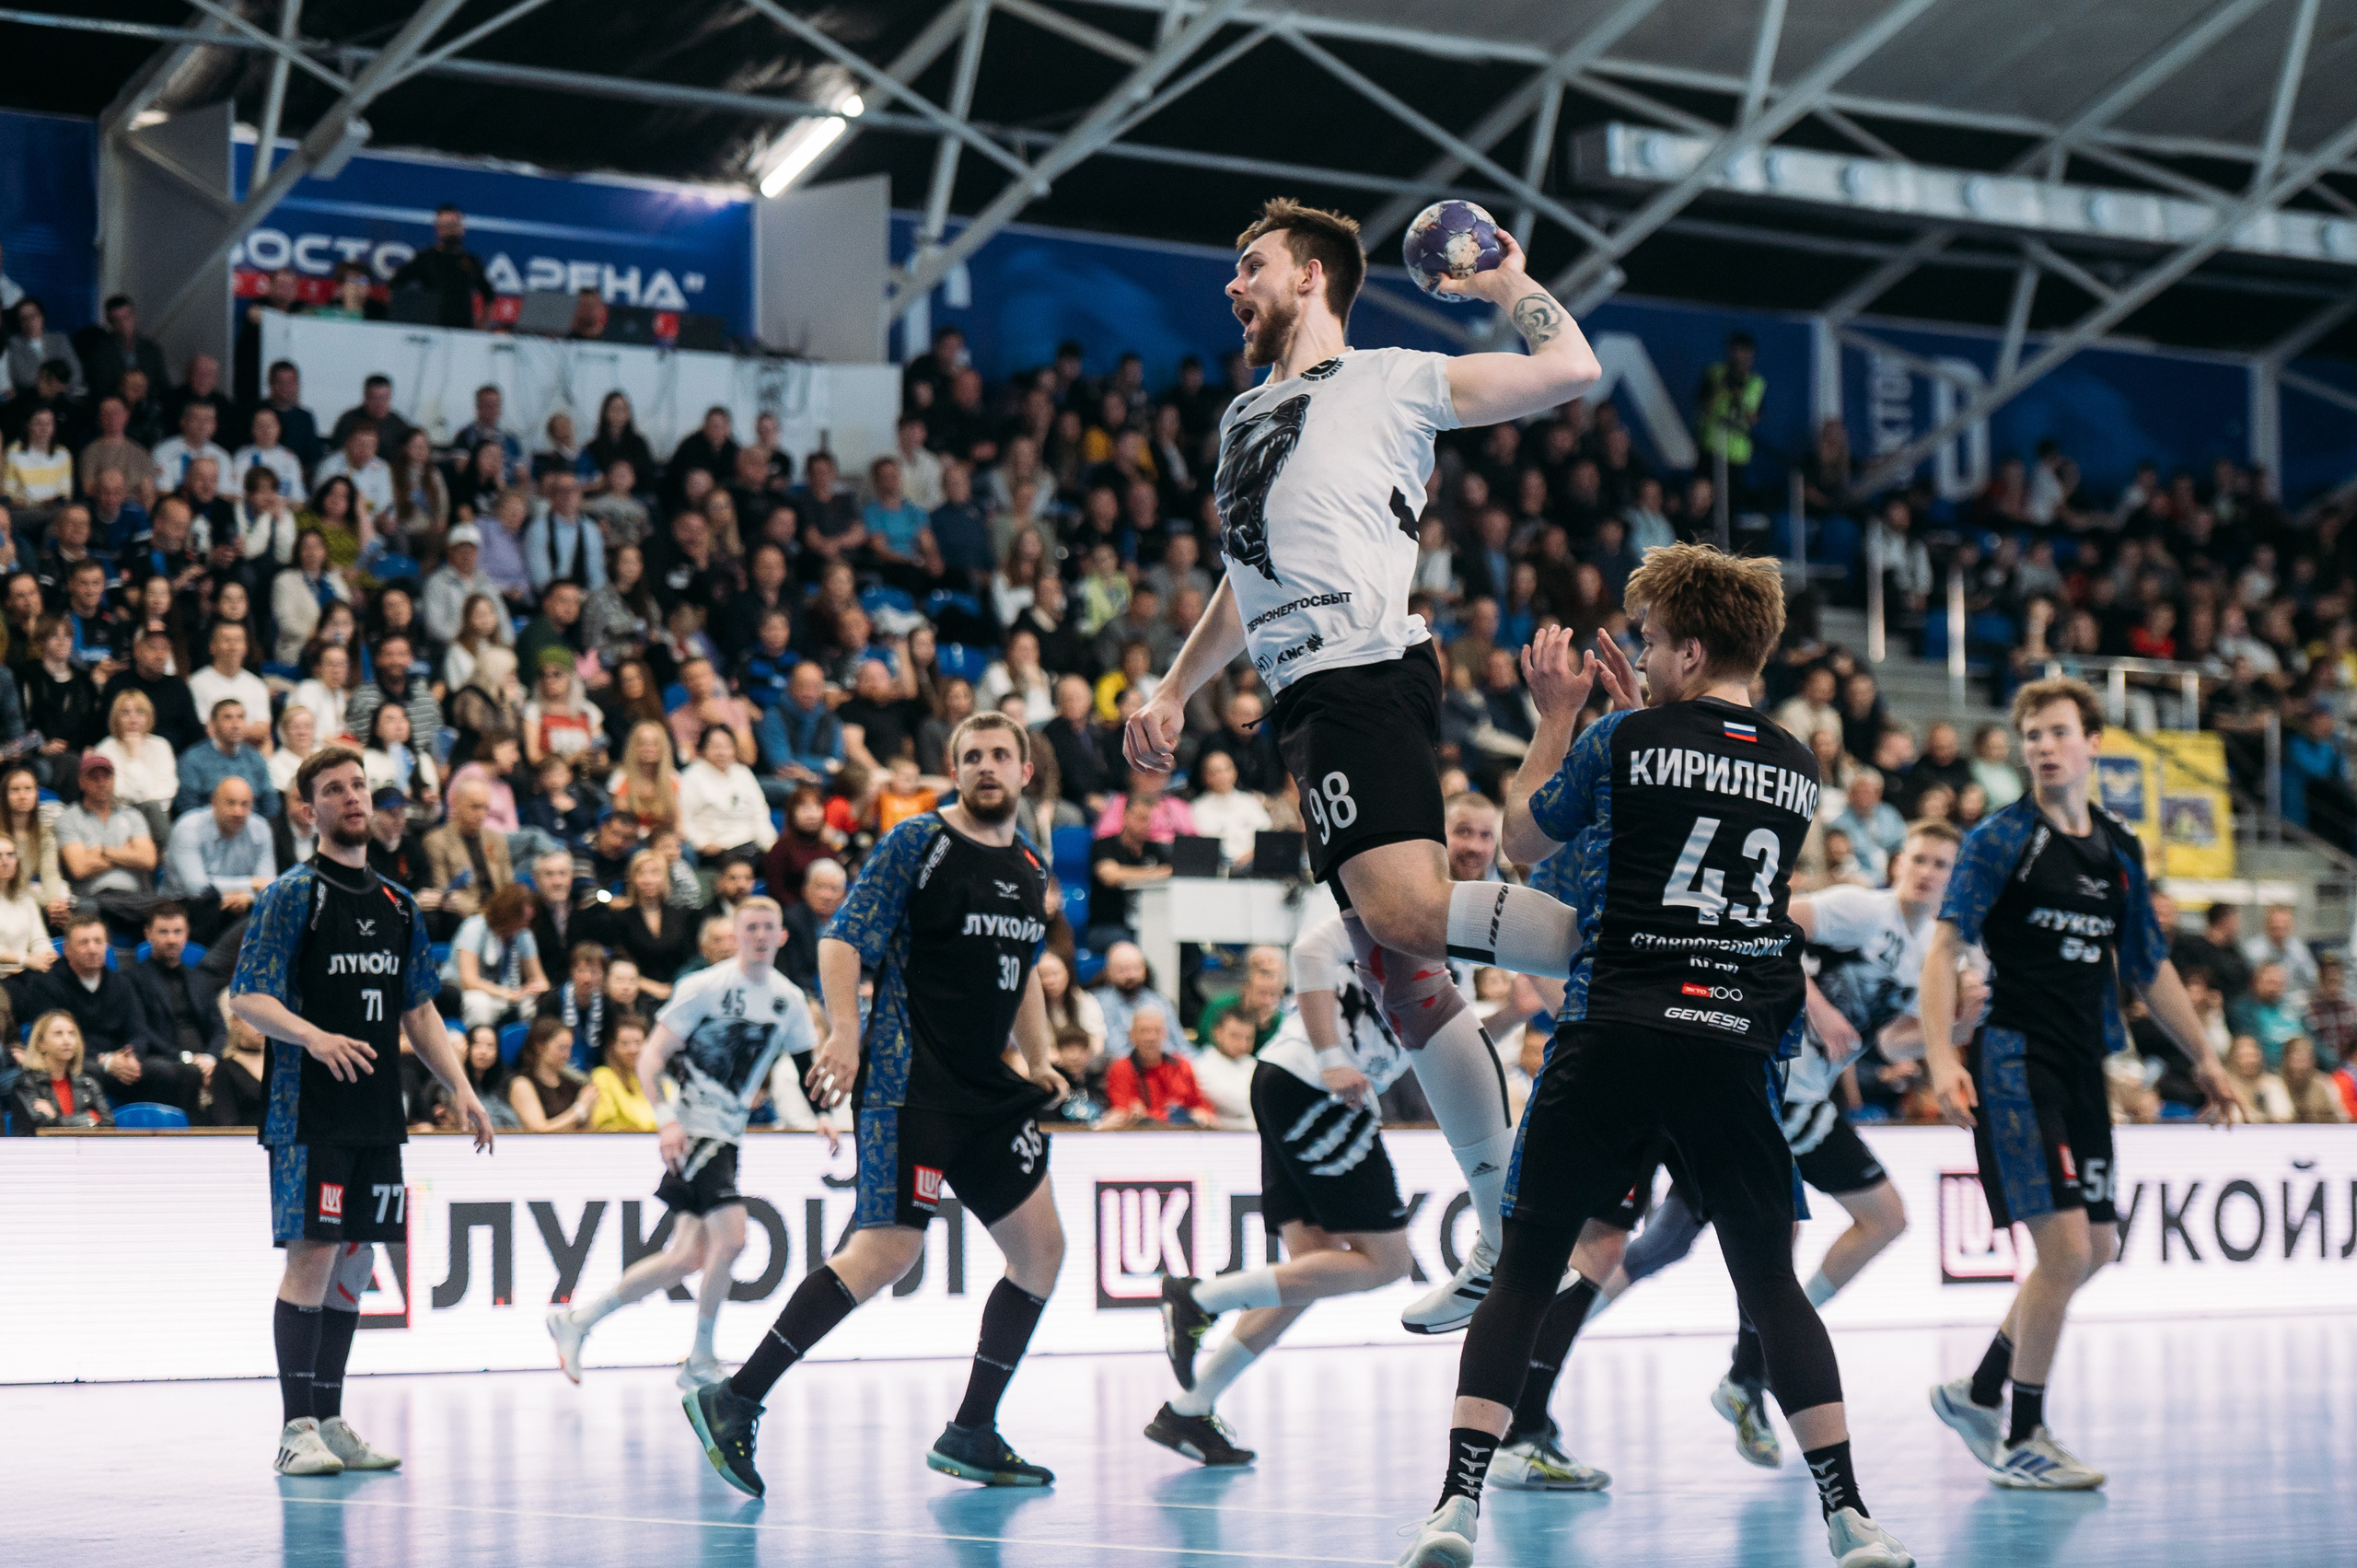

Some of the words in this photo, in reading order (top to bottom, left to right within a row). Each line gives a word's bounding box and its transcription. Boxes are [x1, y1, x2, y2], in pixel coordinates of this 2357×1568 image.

[1630, 748, 1818, 822] КИРИЛЕНКО
[1308, 771, 1357, 845] 98
[1662, 816, 1781, 928] 43
[997, 954, 1020, 992] 30
[721, 987, 747, 1016] 45
[1664, 1006, 1751, 1031] GENESIS
[372, 1184, 405, 1225] 77
